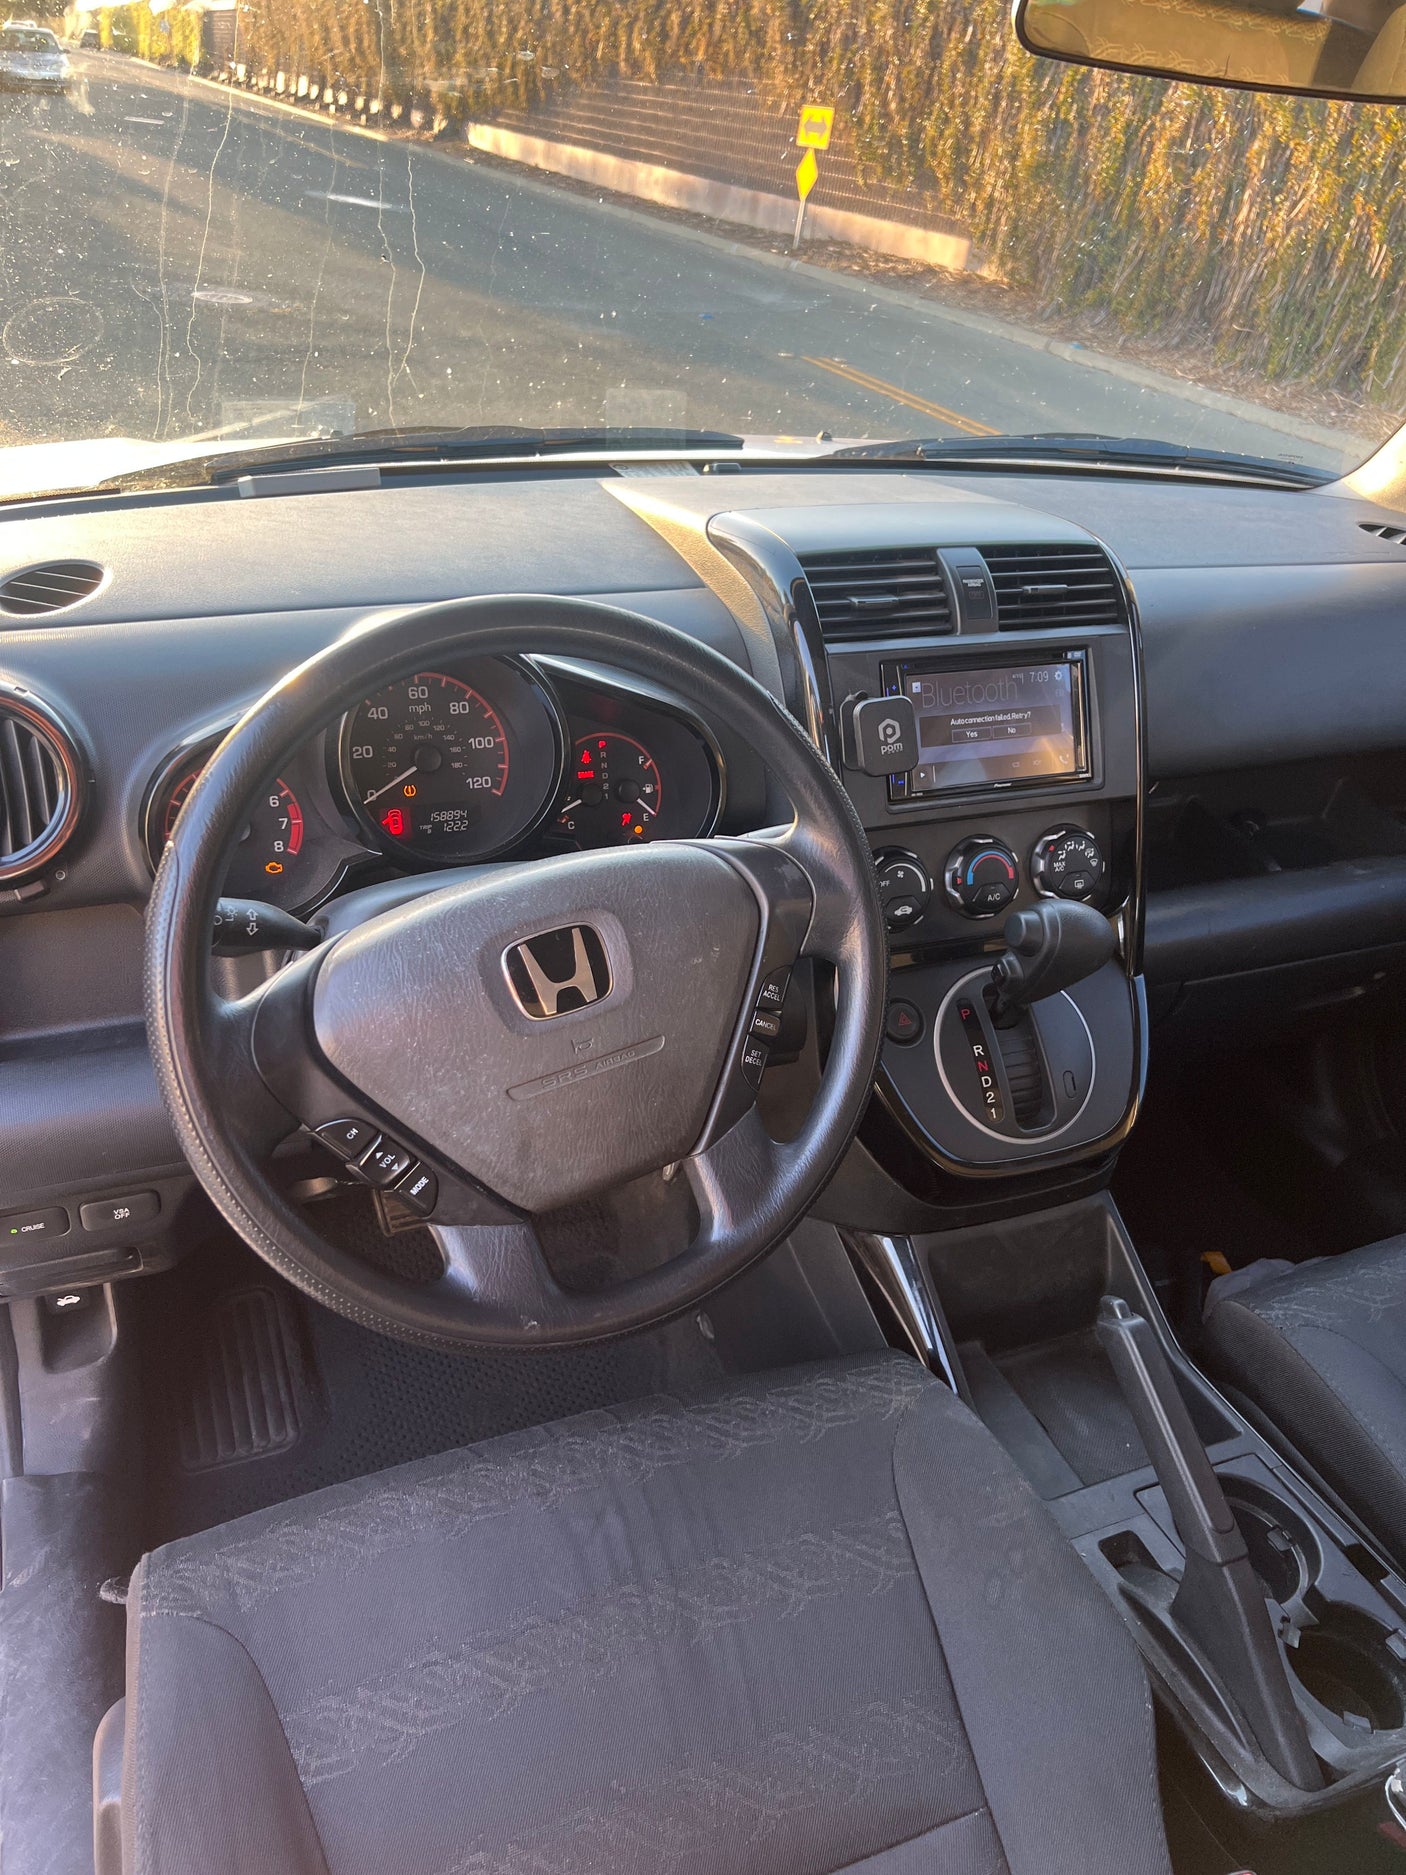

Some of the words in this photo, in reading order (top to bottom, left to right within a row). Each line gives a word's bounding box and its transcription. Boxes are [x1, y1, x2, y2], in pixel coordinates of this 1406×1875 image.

[408, 686, 429, 699] 60
[922, 676, 1019, 709] Bluetooth
[367, 706, 389, 720] 40
[409, 702, 432, 715] mph
[450, 701, 470, 714] 80
[965, 730, 978, 738] Yes
[468, 736, 494, 749] 100
[598, 740, 606, 749] P
[352, 745, 374, 759] 20
[638, 756, 645, 765] F
[466, 776, 492, 789] 120
[269, 795, 280, 808] 6
[430, 810, 468, 822] 158894
[643, 813, 650, 822] E
[278, 818, 288, 830] 7
[567, 821, 575, 830] C
[273, 840, 284, 852] 8
[987, 893, 1001, 902] A/C
[768, 984, 779, 992] RES
[762, 990, 780, 1002] ACCEL
[960, 1008, 971, 1020] P
[755, 1018, 776, 1031] CANCEL
[750, 1049, 762, 1058] SET
[972, 1044, 985, 1057] R
[744, 1055, 762, 1067] DECEL
[977, 1060, 989, 1072] N
[541, 1065, 588, 1089] SRS
[981, 1075, 992, 1088] D
[985, 1091, 996, 1104] 2
[990, 1107, 997, 1119] 1
[346, 1127, 359, 1140] CH
[379, 1154, 396, 1169] VOL
[410, 1176, 430, 1196] MODE
[113, 1207, 130, 1215] VSA
[114, 1212, 130, 1220] OFF
[21, 1222, 45, 1233] CRUISE
